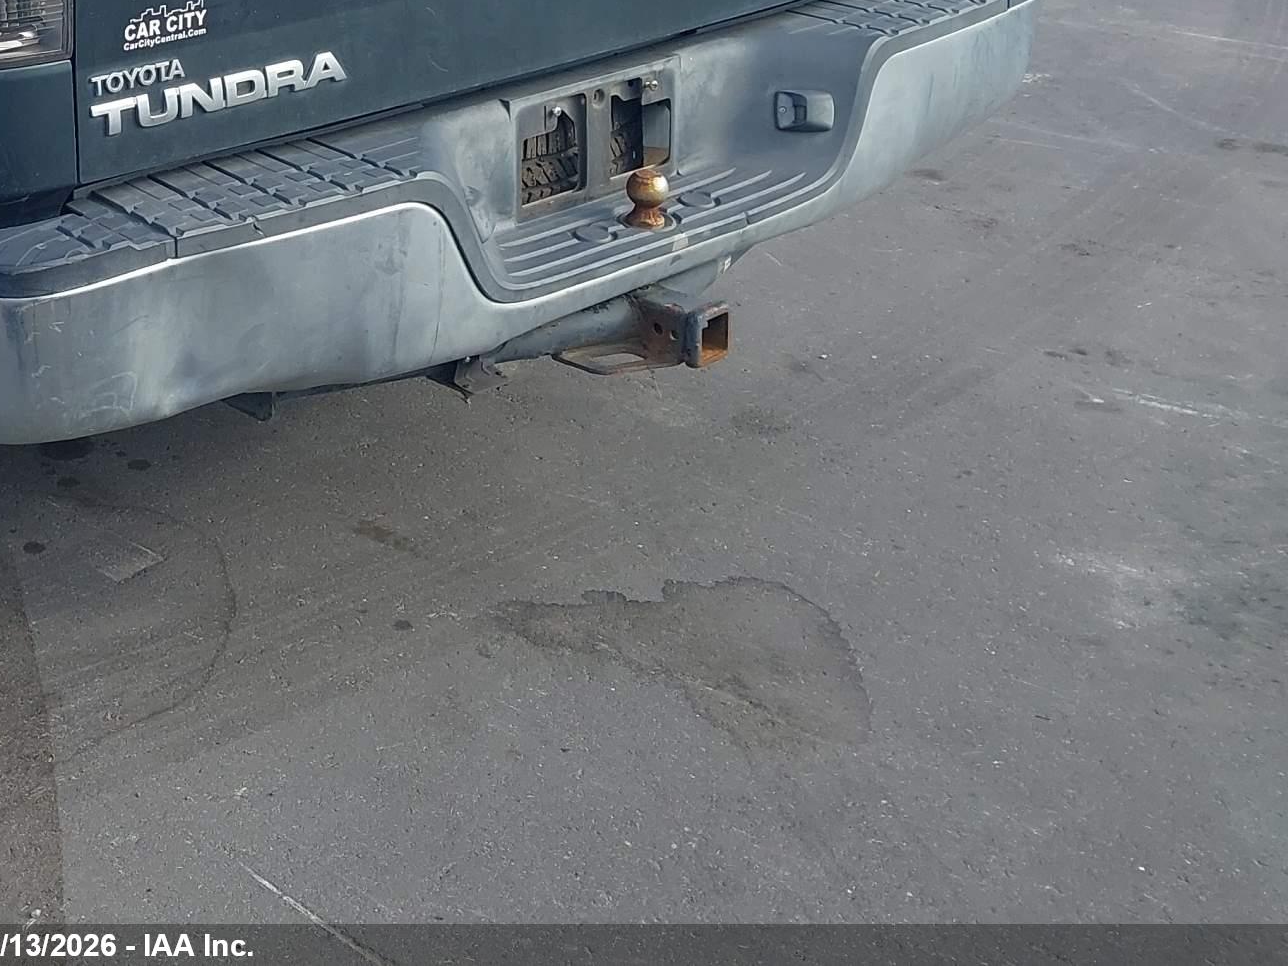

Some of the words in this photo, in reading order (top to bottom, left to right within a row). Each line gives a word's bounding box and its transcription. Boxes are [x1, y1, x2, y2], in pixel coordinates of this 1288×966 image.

[123, 28, 207, 51] CarCityCentral.Com
[124, 19, 161, 41] CAR
[166, 9, 207, 32] CITY
[90, 51, 347, 136] TUNDRA
[91, 58, 185, 96] TOYOTA
